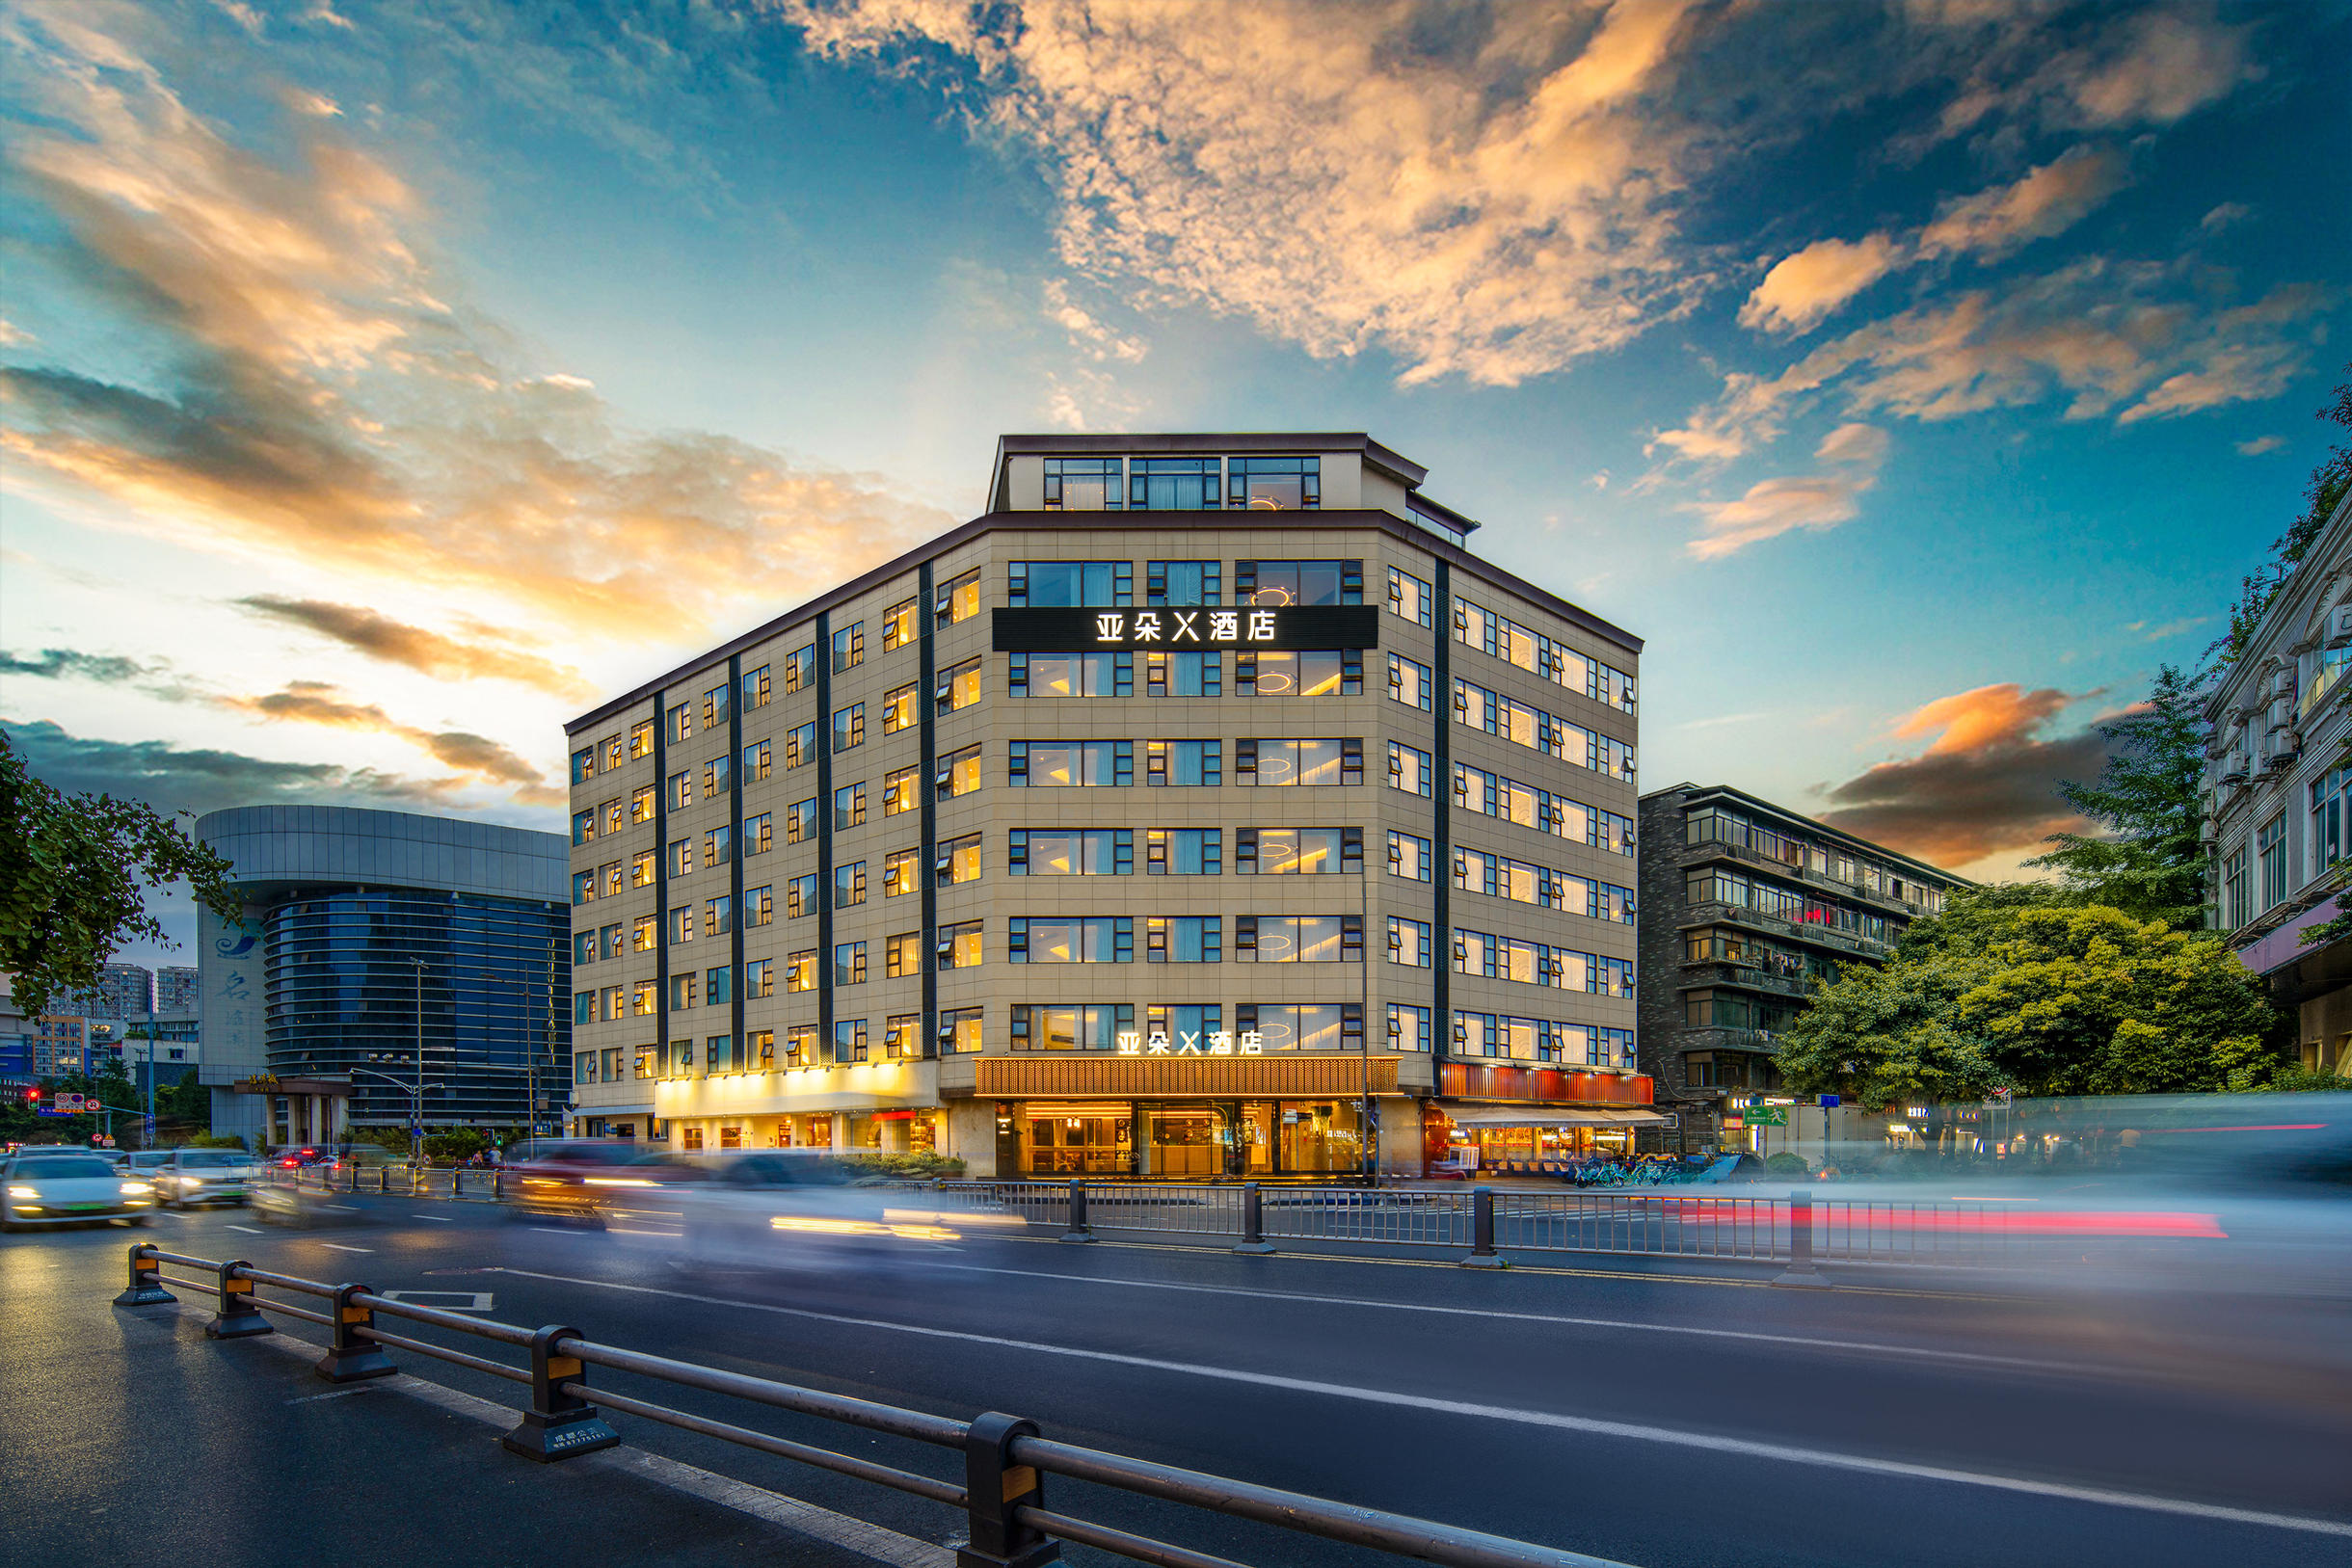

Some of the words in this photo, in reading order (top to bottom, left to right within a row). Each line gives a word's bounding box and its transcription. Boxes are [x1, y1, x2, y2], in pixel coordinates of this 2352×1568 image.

[1096, 610, 1276, 642] 亚朵X酒店
[1117, 1029, 1265, 1056] 亚朵X酒店
